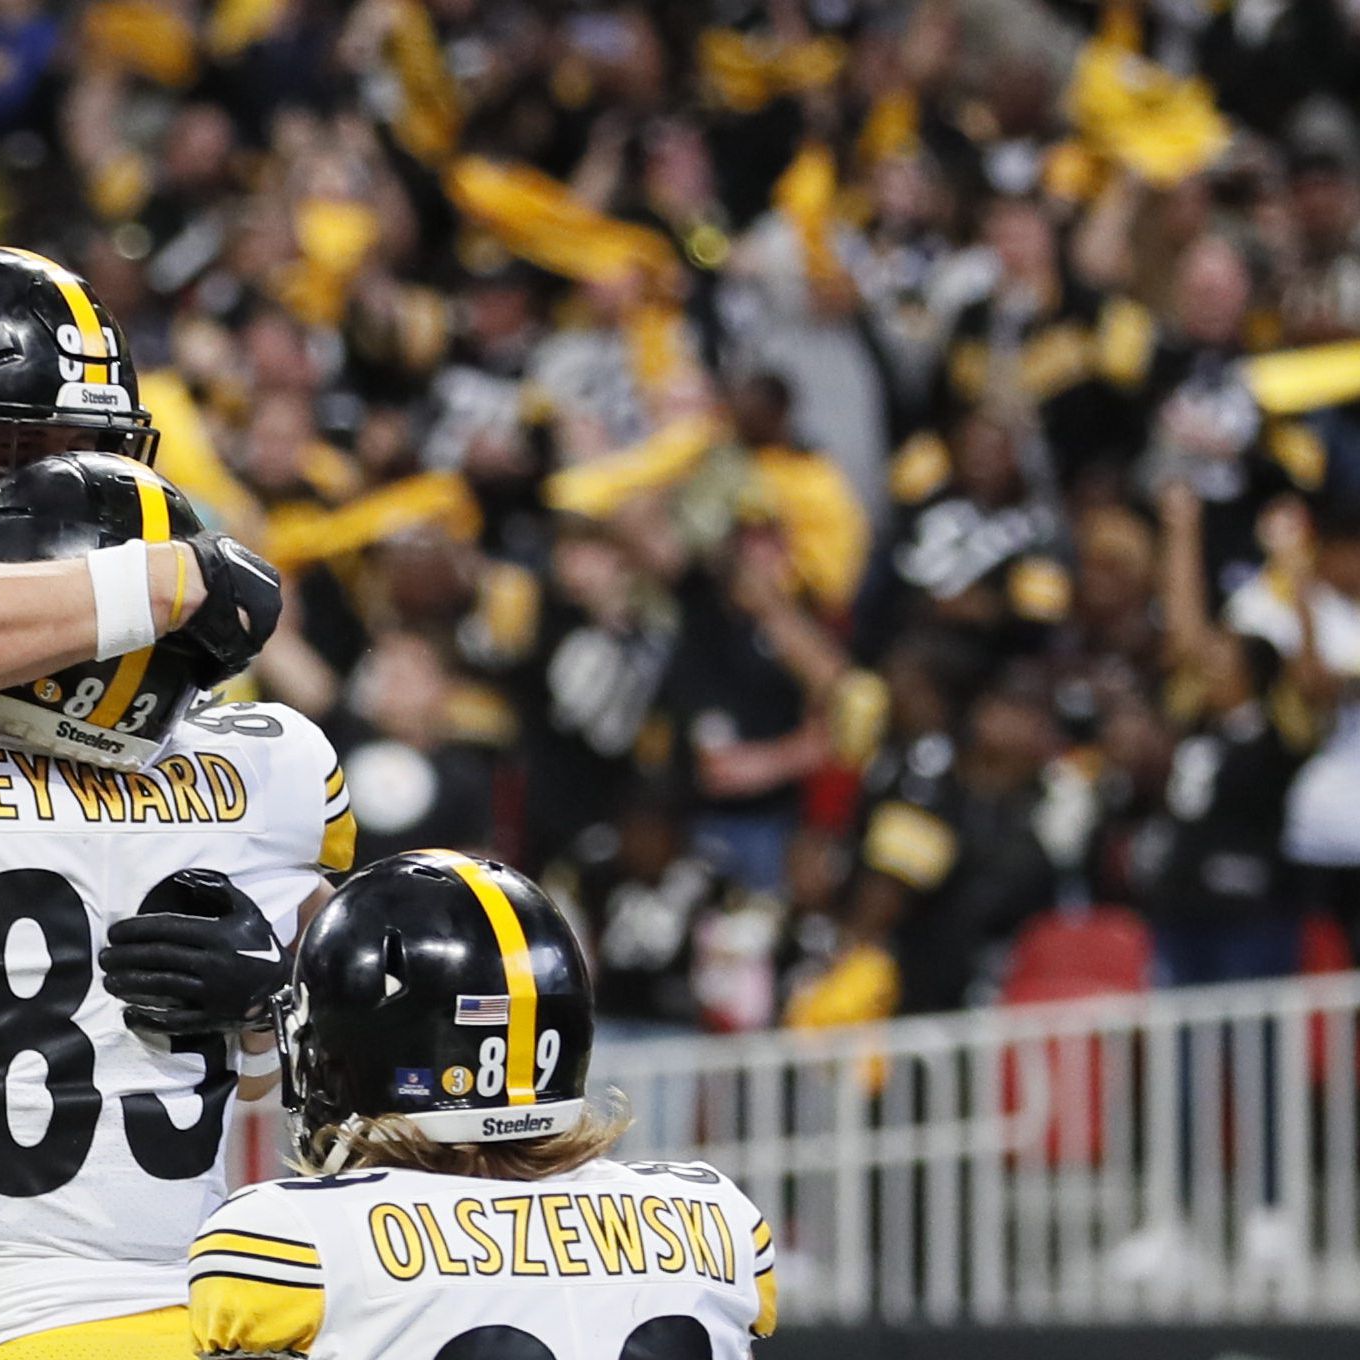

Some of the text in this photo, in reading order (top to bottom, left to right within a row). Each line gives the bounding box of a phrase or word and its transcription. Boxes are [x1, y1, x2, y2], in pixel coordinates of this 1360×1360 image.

[56, 323, 121, 385] 81
[40, 681, 56, 700] 3
[62, 676, 158, 734] 83
[56, 719, 125, 755] Steelers
[451, 1067, 467, 1094] 3
[476, 1028, 561, 1098] 89
[482, 1113, 554, 1137] Steelers
[368, 1192, 736, 1285] OLSZEWSKI
